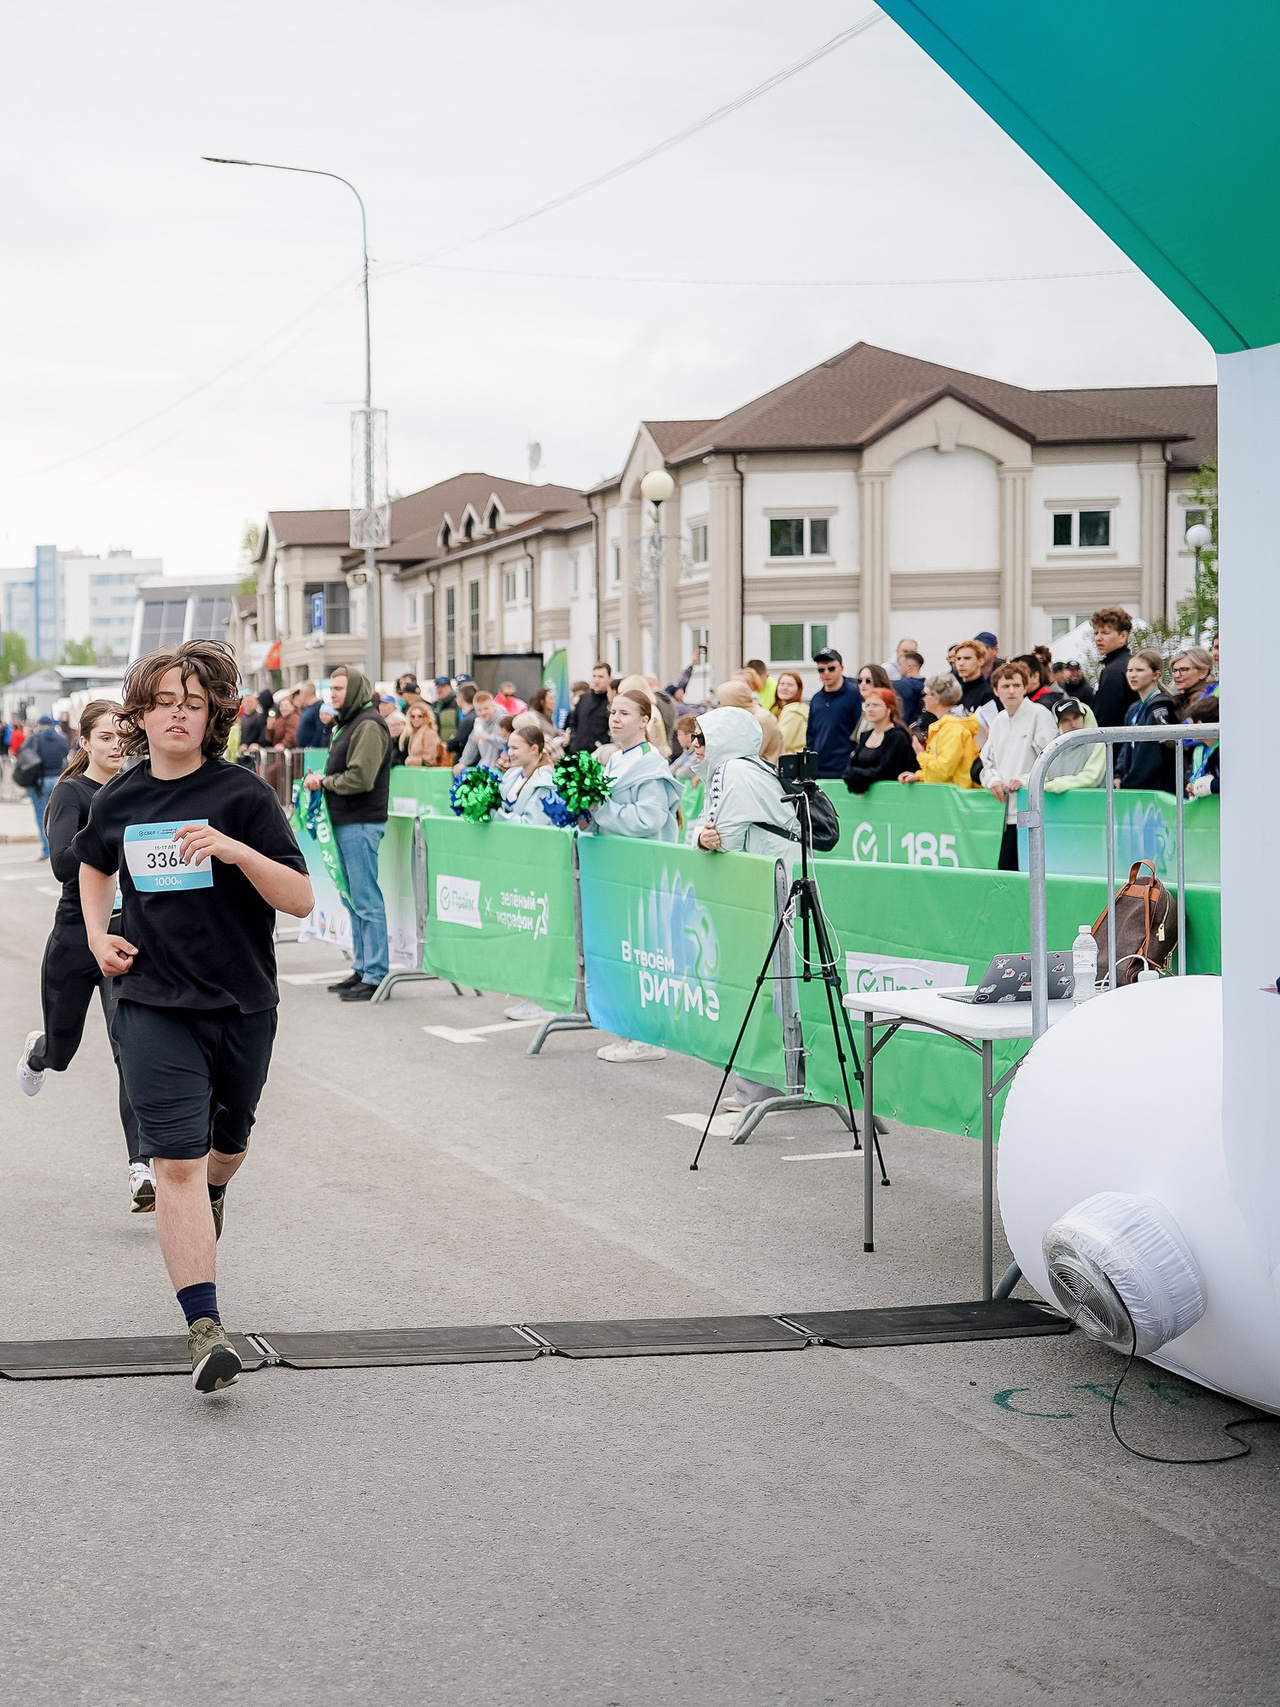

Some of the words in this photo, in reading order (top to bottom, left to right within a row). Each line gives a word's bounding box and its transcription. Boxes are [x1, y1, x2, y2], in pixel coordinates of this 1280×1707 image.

[901, 832, 959, 867] 185
[500, 888, 536, 911] зелёный
[496, 909, 534, 932] марафон
[621, 940, 632, 962] В
[633, 948, 675, 974] твоём
[639, 970, 720, 1021] ритме
